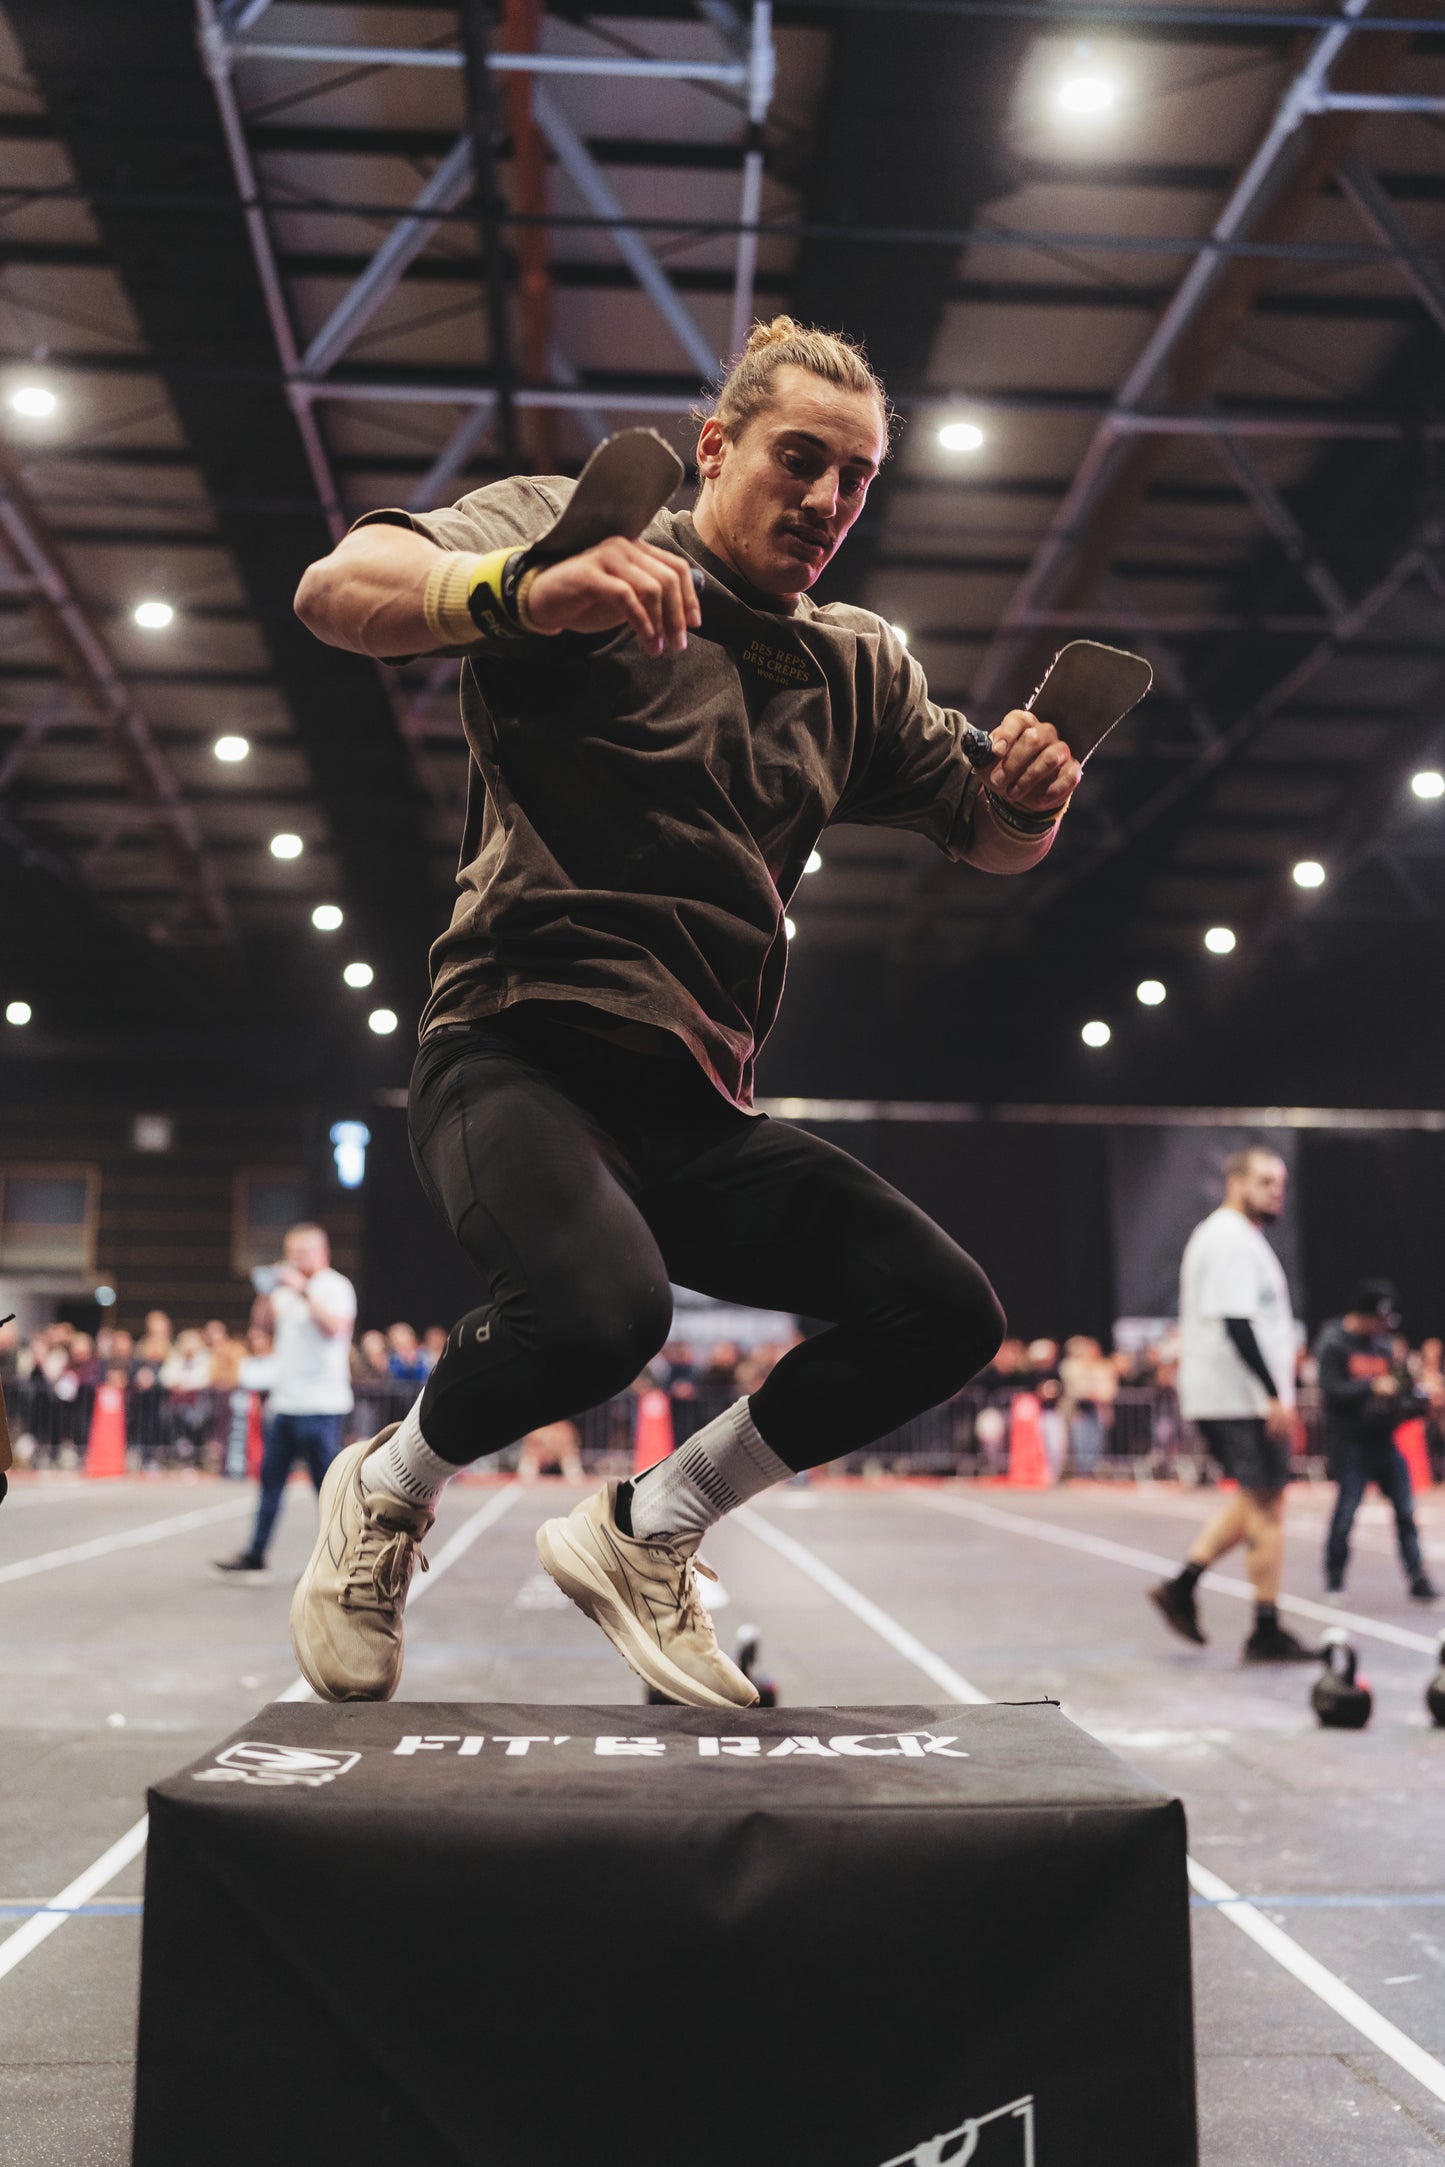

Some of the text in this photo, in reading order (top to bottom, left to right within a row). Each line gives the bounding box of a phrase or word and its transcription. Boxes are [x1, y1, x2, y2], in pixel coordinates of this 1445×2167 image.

[743, 649, 765, 666] DES
[752, 640, 807, 669] DES REPS
[698, 1731, 972, 1757] RACK
